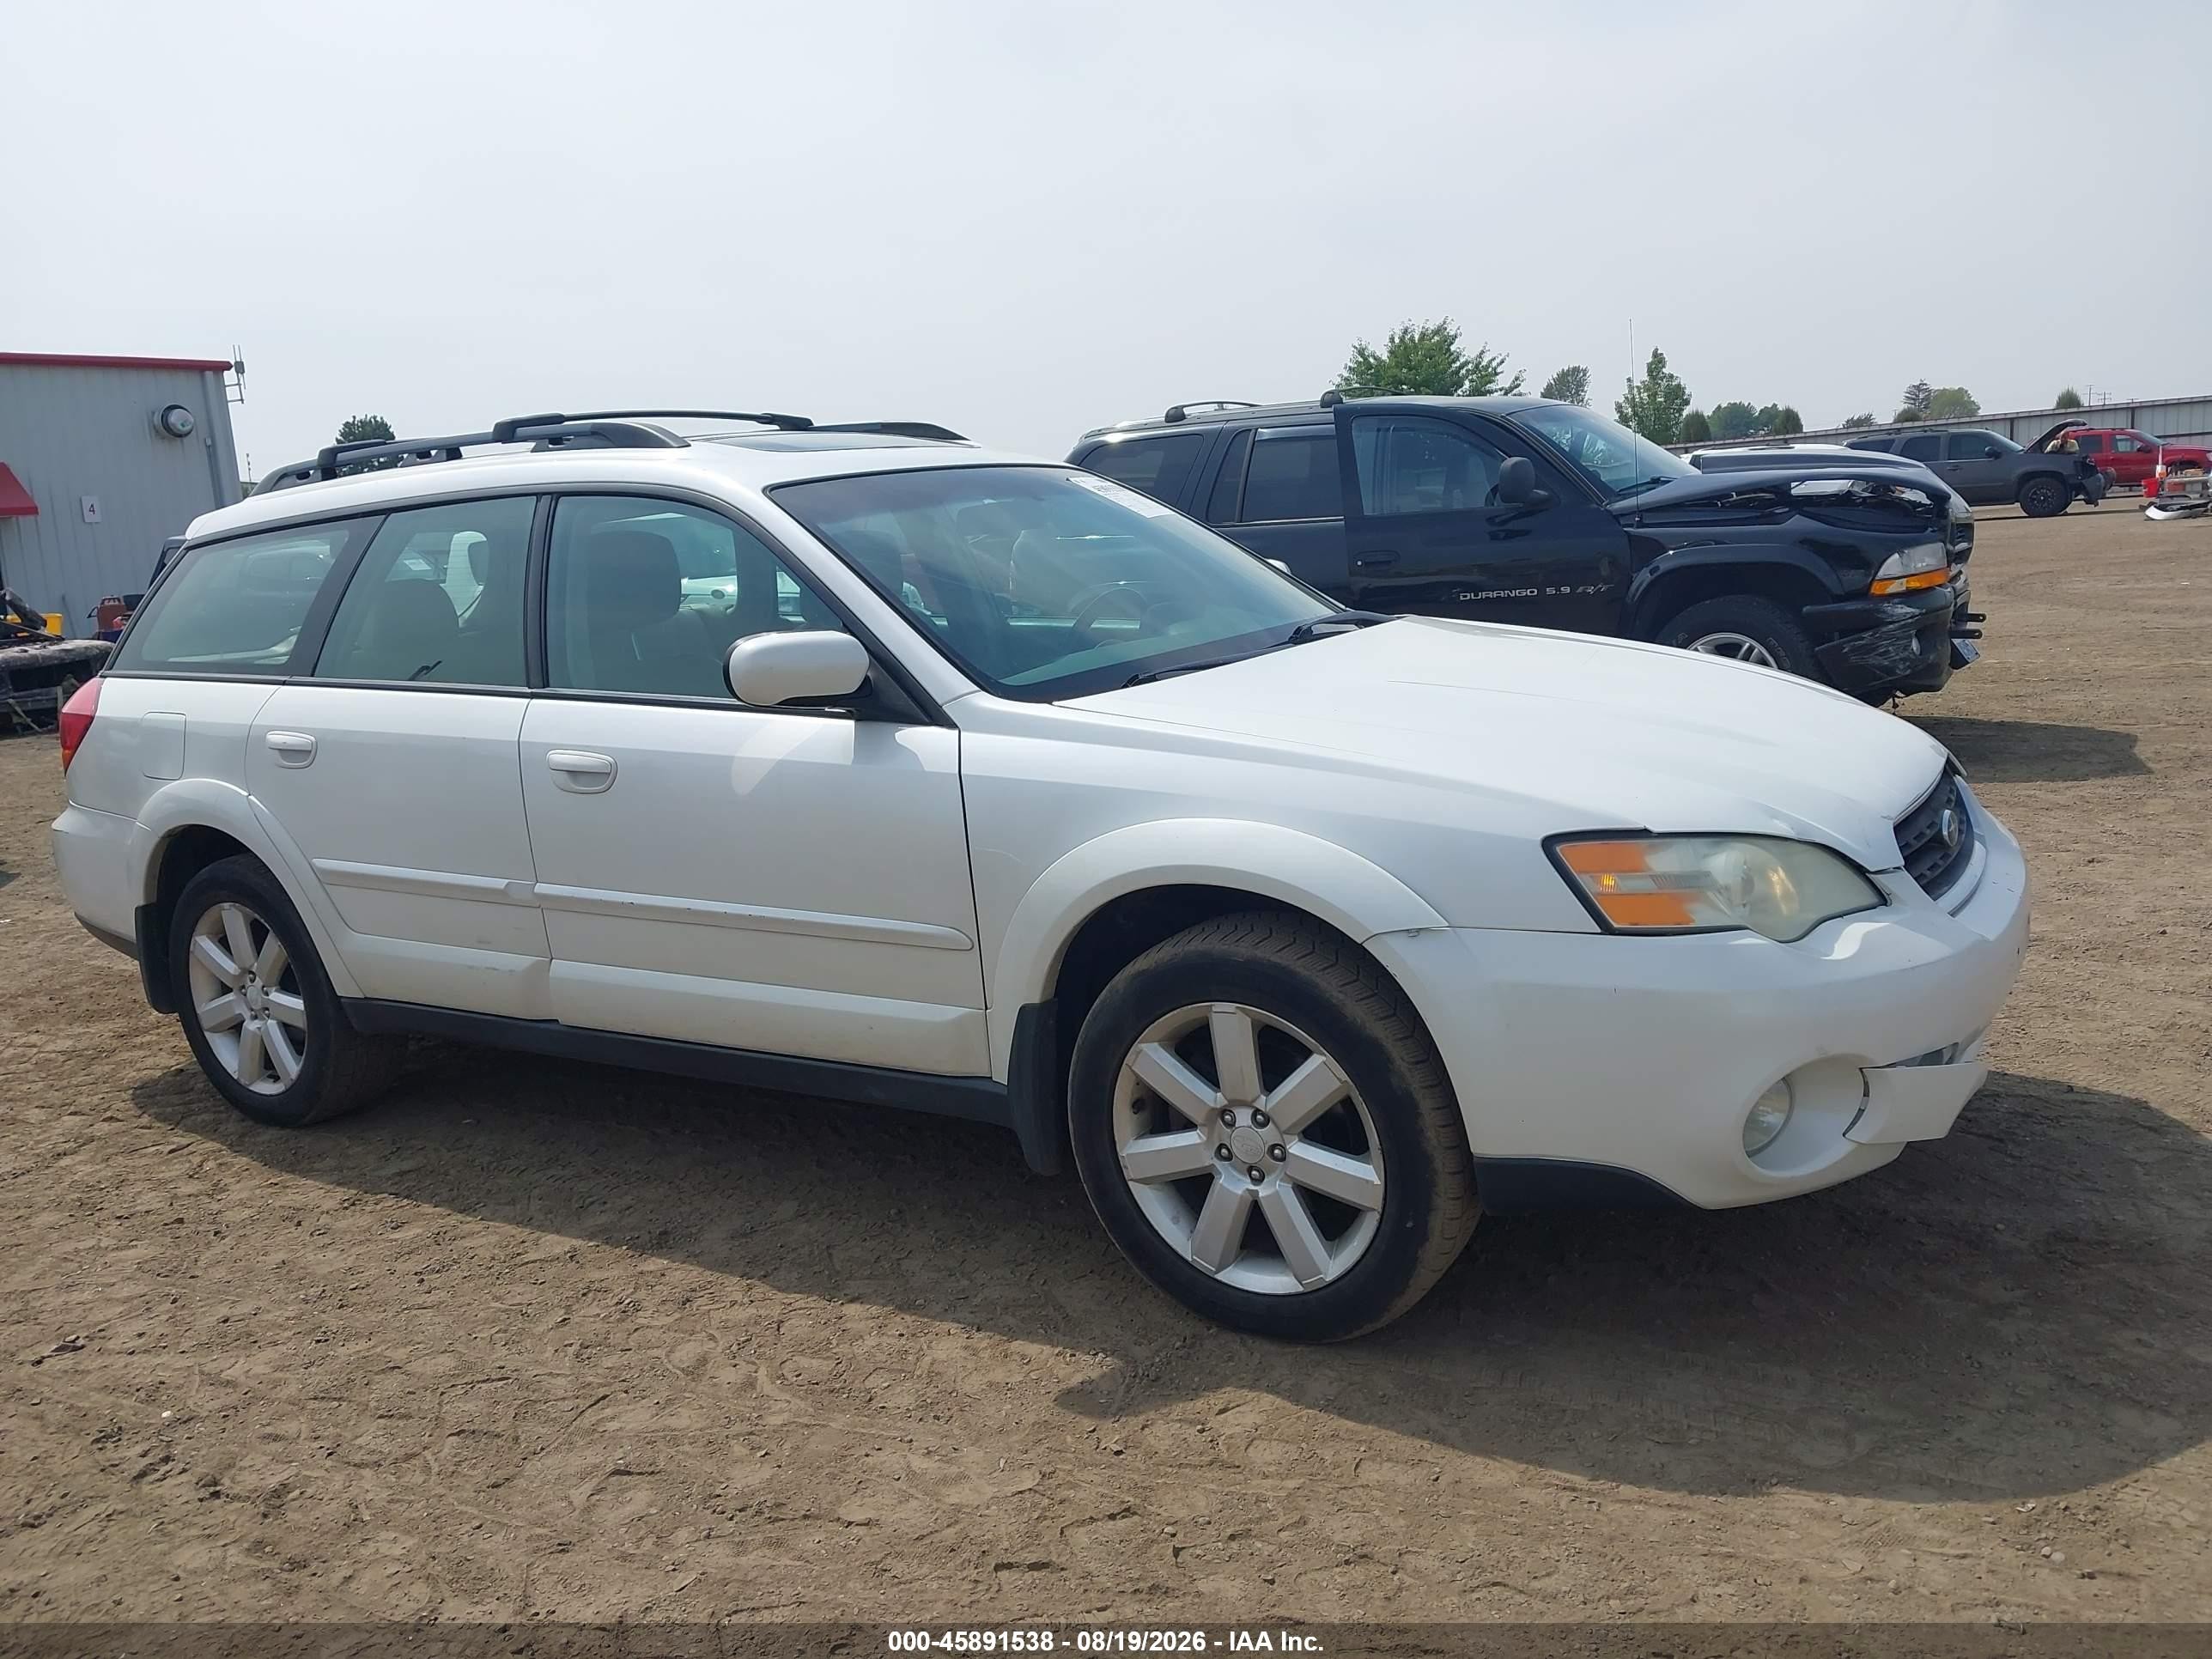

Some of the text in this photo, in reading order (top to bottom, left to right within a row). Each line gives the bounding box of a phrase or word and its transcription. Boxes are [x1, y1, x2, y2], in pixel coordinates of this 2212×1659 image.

[88, 503, 95, 515] 4
[1460, 588, 1538, 600] DURANGO
[1546, 586, 1571, 595] 5.9
